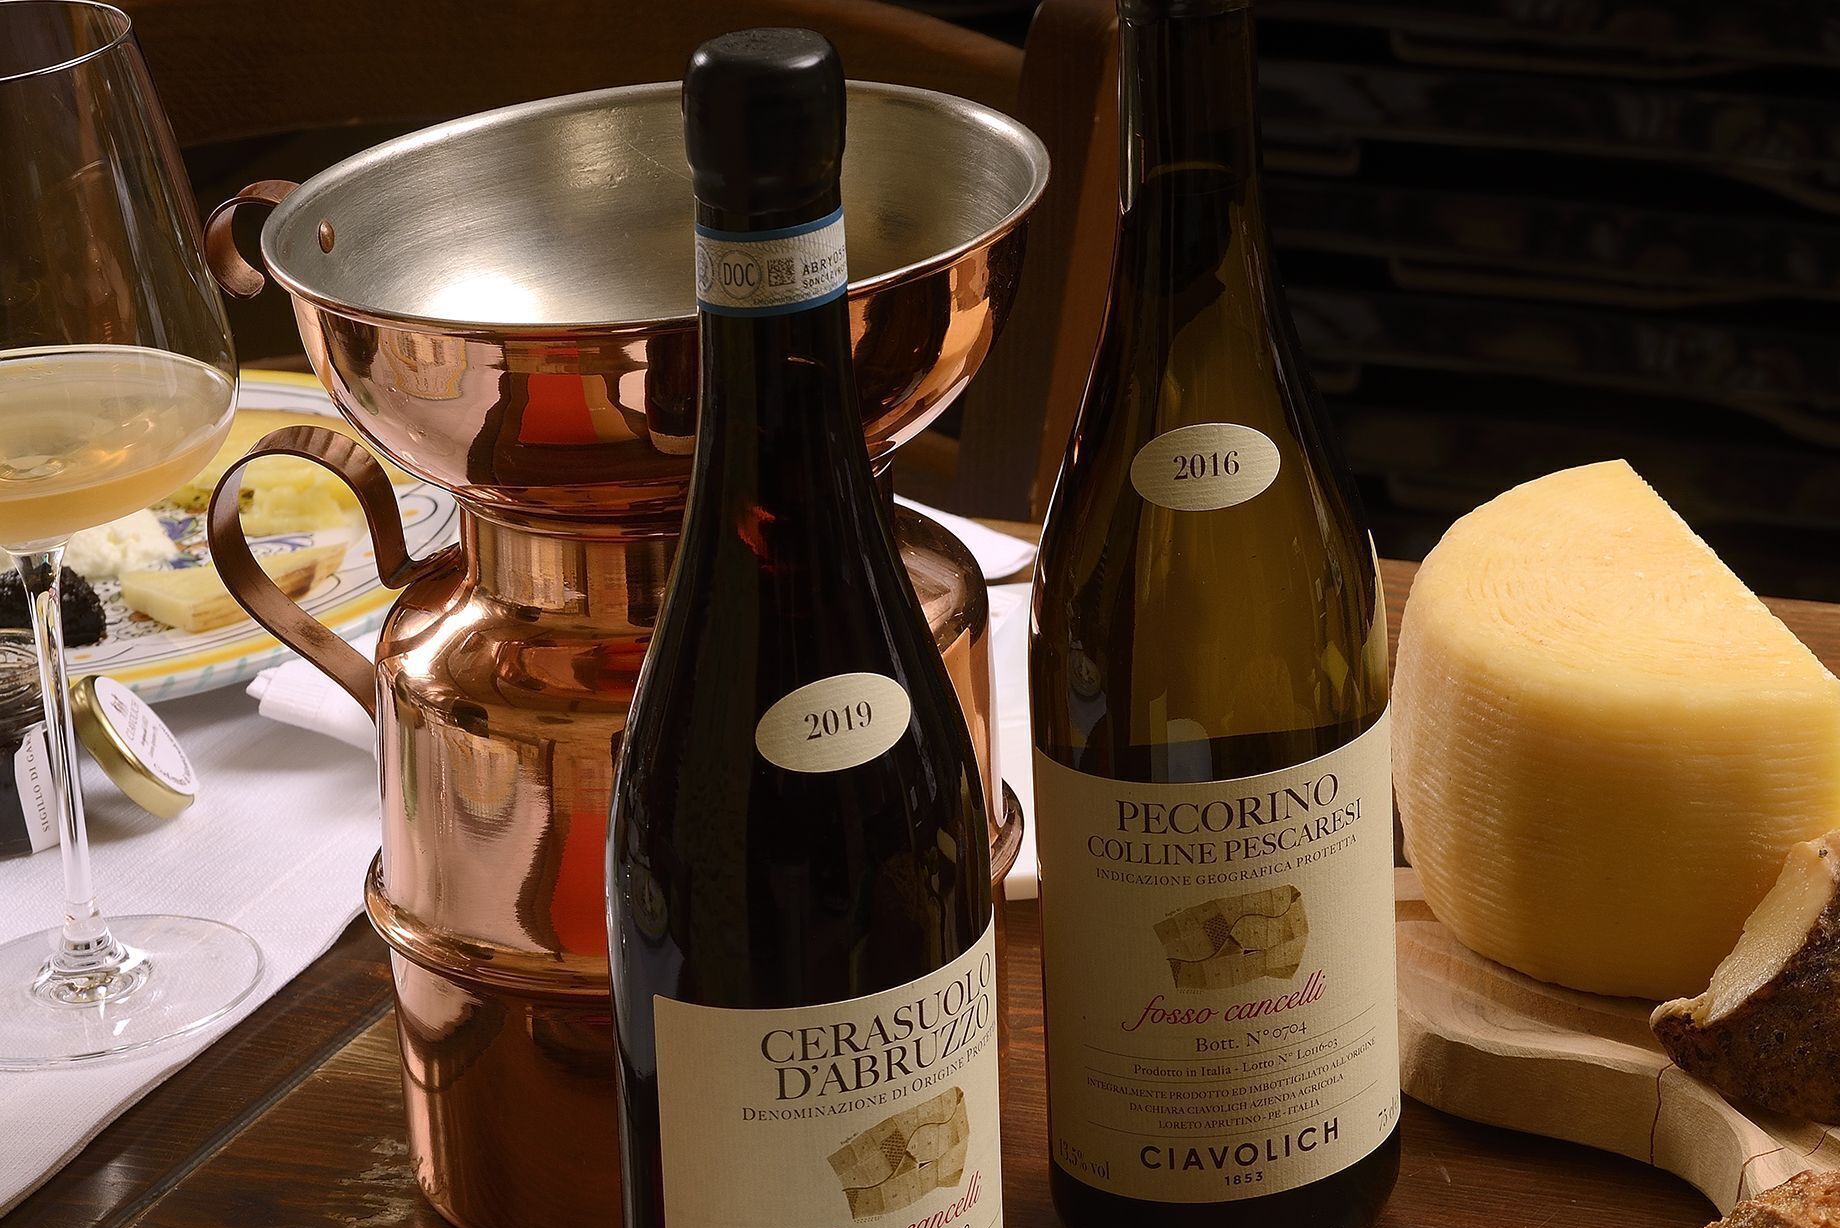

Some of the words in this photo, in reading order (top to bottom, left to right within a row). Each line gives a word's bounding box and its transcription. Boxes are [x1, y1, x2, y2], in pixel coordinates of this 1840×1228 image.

[723, 262, 755, 287] DOC
[1173, 450, 1241, 482] 2016
[803, 699, 874, 742] 2019
[28, 766, 38, 783] DI
[33, 784, 50, 833] SIGILLO
[1116, 773, 1339, 835] PECORINO
[1087, 835, 1217, 865] COLLINE
[1224, 797, 1362, 862] PESCARESI
[1096, 867, 1192, 886] INDICAZIONE
[1196, 862, 1293, 886] GEOGRAFICA
[1296, 833, 1358, 868] PROTETTA
[761, 952, 991, 1064] CERASUOLO
[1121, 995, 1220, 1031] fosso
[1224, 969, 1328, 1022] cancelli
[775, 994, 989, 1100] D'ABRUZZO
[1195, 1037, 1240, 1052] Bott.
[742, 1093, 887, 1121] DENOMINAZIONE
[891, 1086, 907, 1101] DI
[912, 1059, 965, 1092] ORIGINE
[1087, 1076, 1168, 1099] INTEGRALMENTE
[1169, 1089, 1230, 1100] PRODOTTO
[1231, 1086, 1247, 1097] ED
[1249, 1064, 1329, 1094] IMBOTTIGLIATO
[1330, 1036, 1376, 1069] ALL'ORIGINE
[1133, 1064, 1183, 1077] Prodotto
[1186, 1067, 1197, 1077] in
[1201, 1065, 1231, 1077] Italia
[1242, 1059, 1275, 1073] Lotto
[1129, 1102, 1145, 1112] DA
[1145, 1104, 1185, 1115] CHIARA
[1187, 1101, 1247, 1115] CIAVOLICH
[1250, 1091, 1296, 1109] AZIENDA
[1298, 1073, 1344, 1096] AGRICOLA
[1159, 1119, 1202, 1130] LORETO
[1204, 1114, 1261, 1129] APRUTINO
[1268, 1110, 1281, 1120] PE
[1287, 1098, 1320, 1116] ITALIA
[1139, 1117, 1339, 1171] CIAVOLICH
[1090, 1160, 1110, 1180] vol
[1224, 1171, 1264, 1187] 1853
